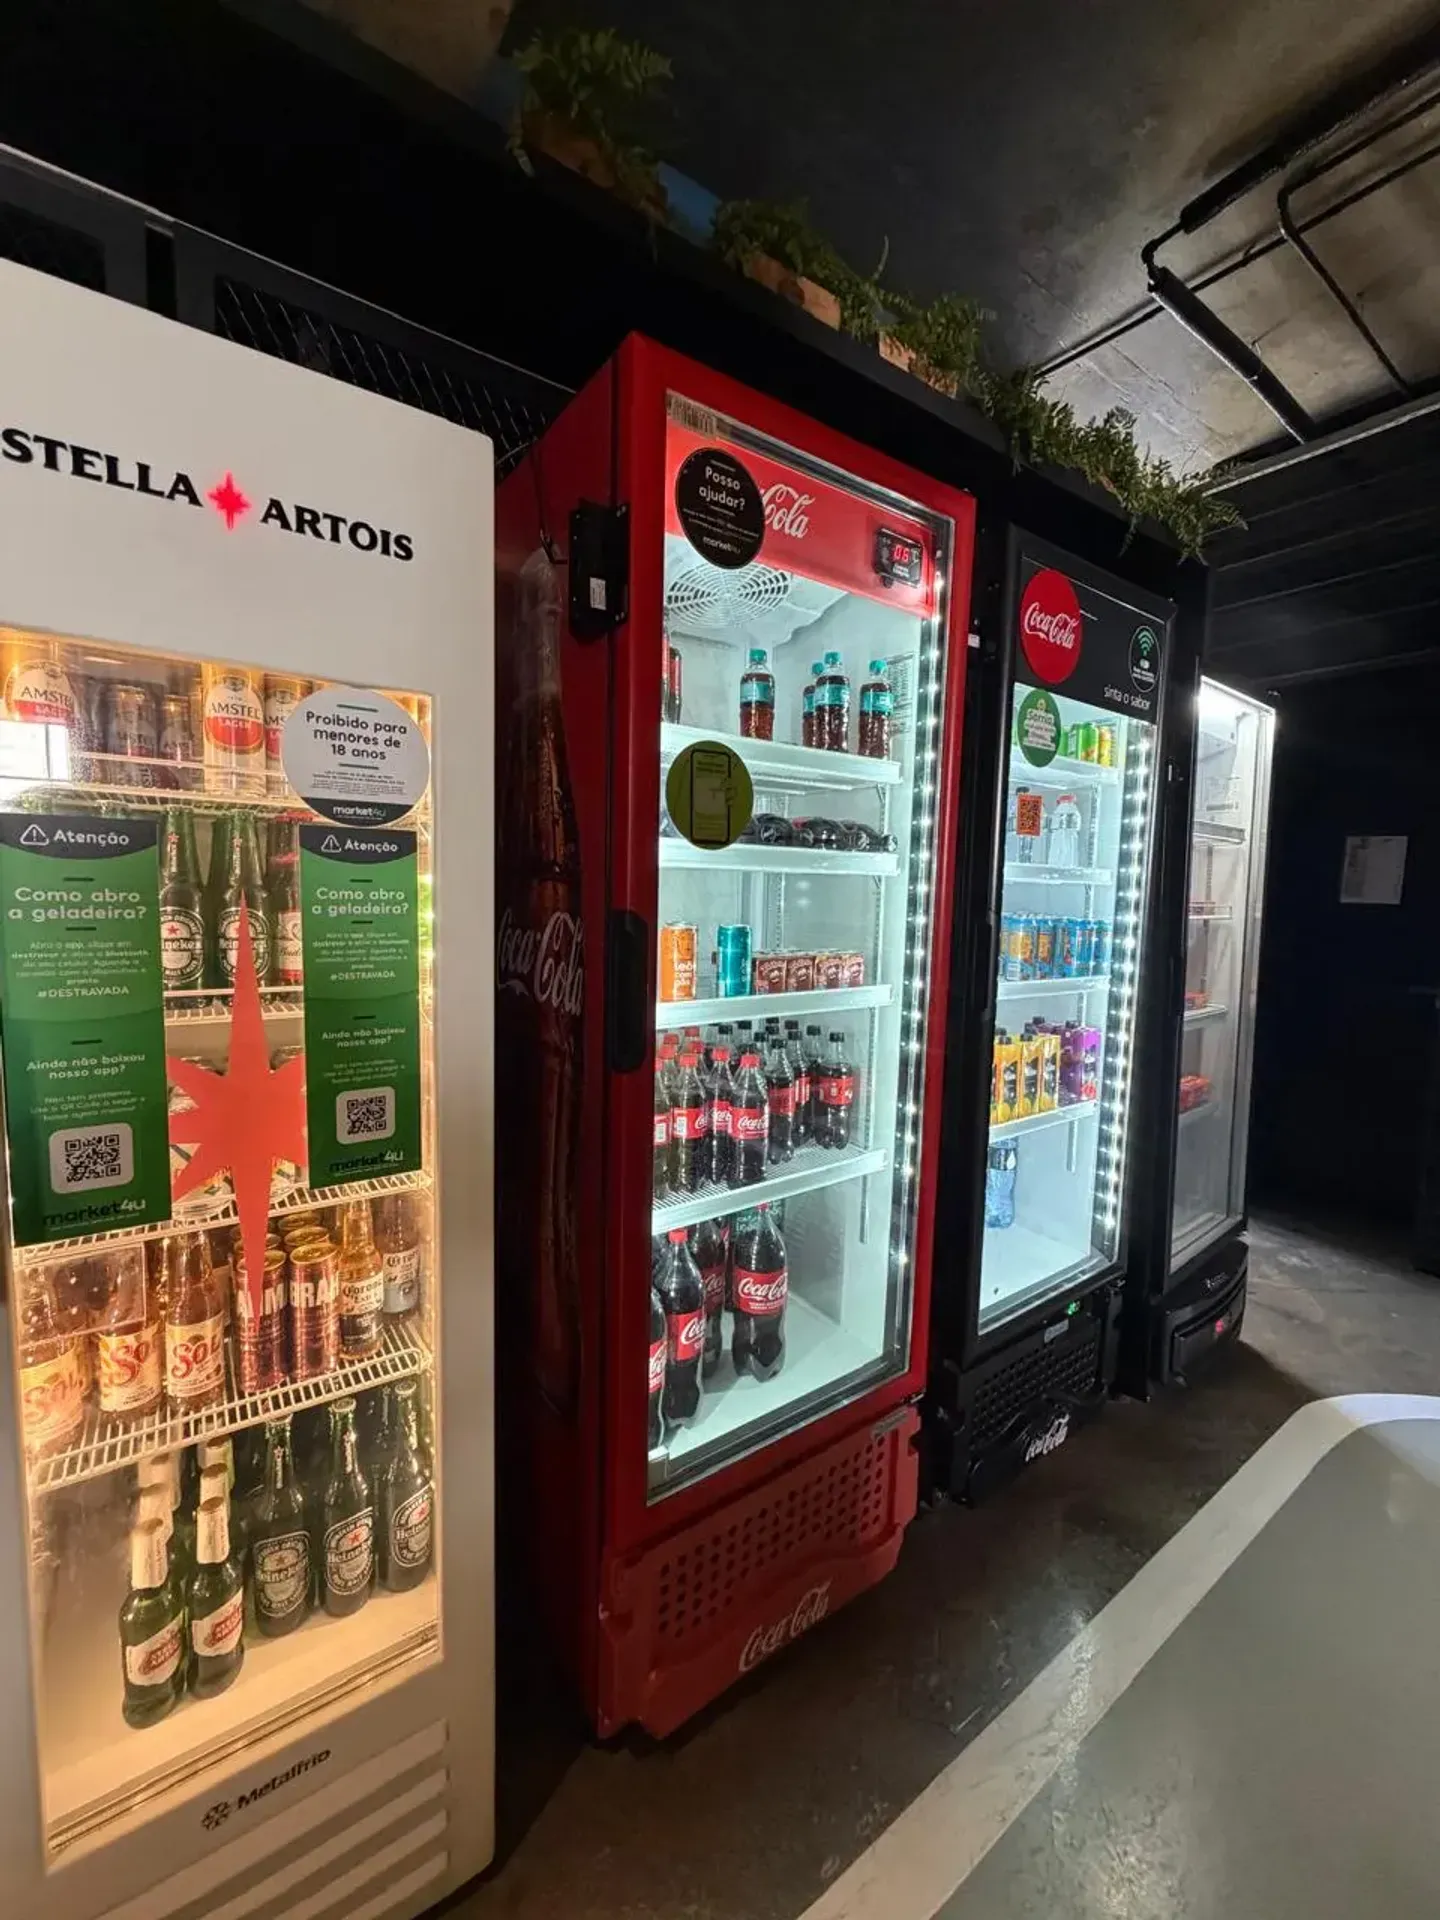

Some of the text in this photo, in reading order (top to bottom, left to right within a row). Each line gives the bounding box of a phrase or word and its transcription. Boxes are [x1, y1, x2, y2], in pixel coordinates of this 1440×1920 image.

[705, 465, 741, 491] Posso
[1, 428, 414, 562] STELLA ARTOIS
[698, 485, 746, 511] ajudar?
[1024, 601, 1079, 649] Coca-Cola
[209, 701, 261, 718] AMSTEL
[305, 710, 408, 736] Proibido para
[313, 727, 402, 749] menores de
[331, 743, 387, 761] 18 anos
[52, 829, 131, 848] Atenção
[344, 836, 399, 853] Atenção
[14, 886, 141, 903] Como abro
[315, 887, 406, 901] Como abro
[8, 905, 147, 923] a geladeira?
[311, 902, 409, 918] a geladeira?
[497, 905, 586, 1017] Coca-Cola
[322, 1030, 351, 1040] Ainda
[26, 1053, 146, 1073] Ainda não baixou
[49, 1063, 126, 1081] nosso app?
[329, 1149, 404, 1174] market4u
[43, 1198, 147, 1228] market4u
[739, 1577, 834, 1673] Coca-Cola
[236, 1748, 333, 1812] Metalfrio
